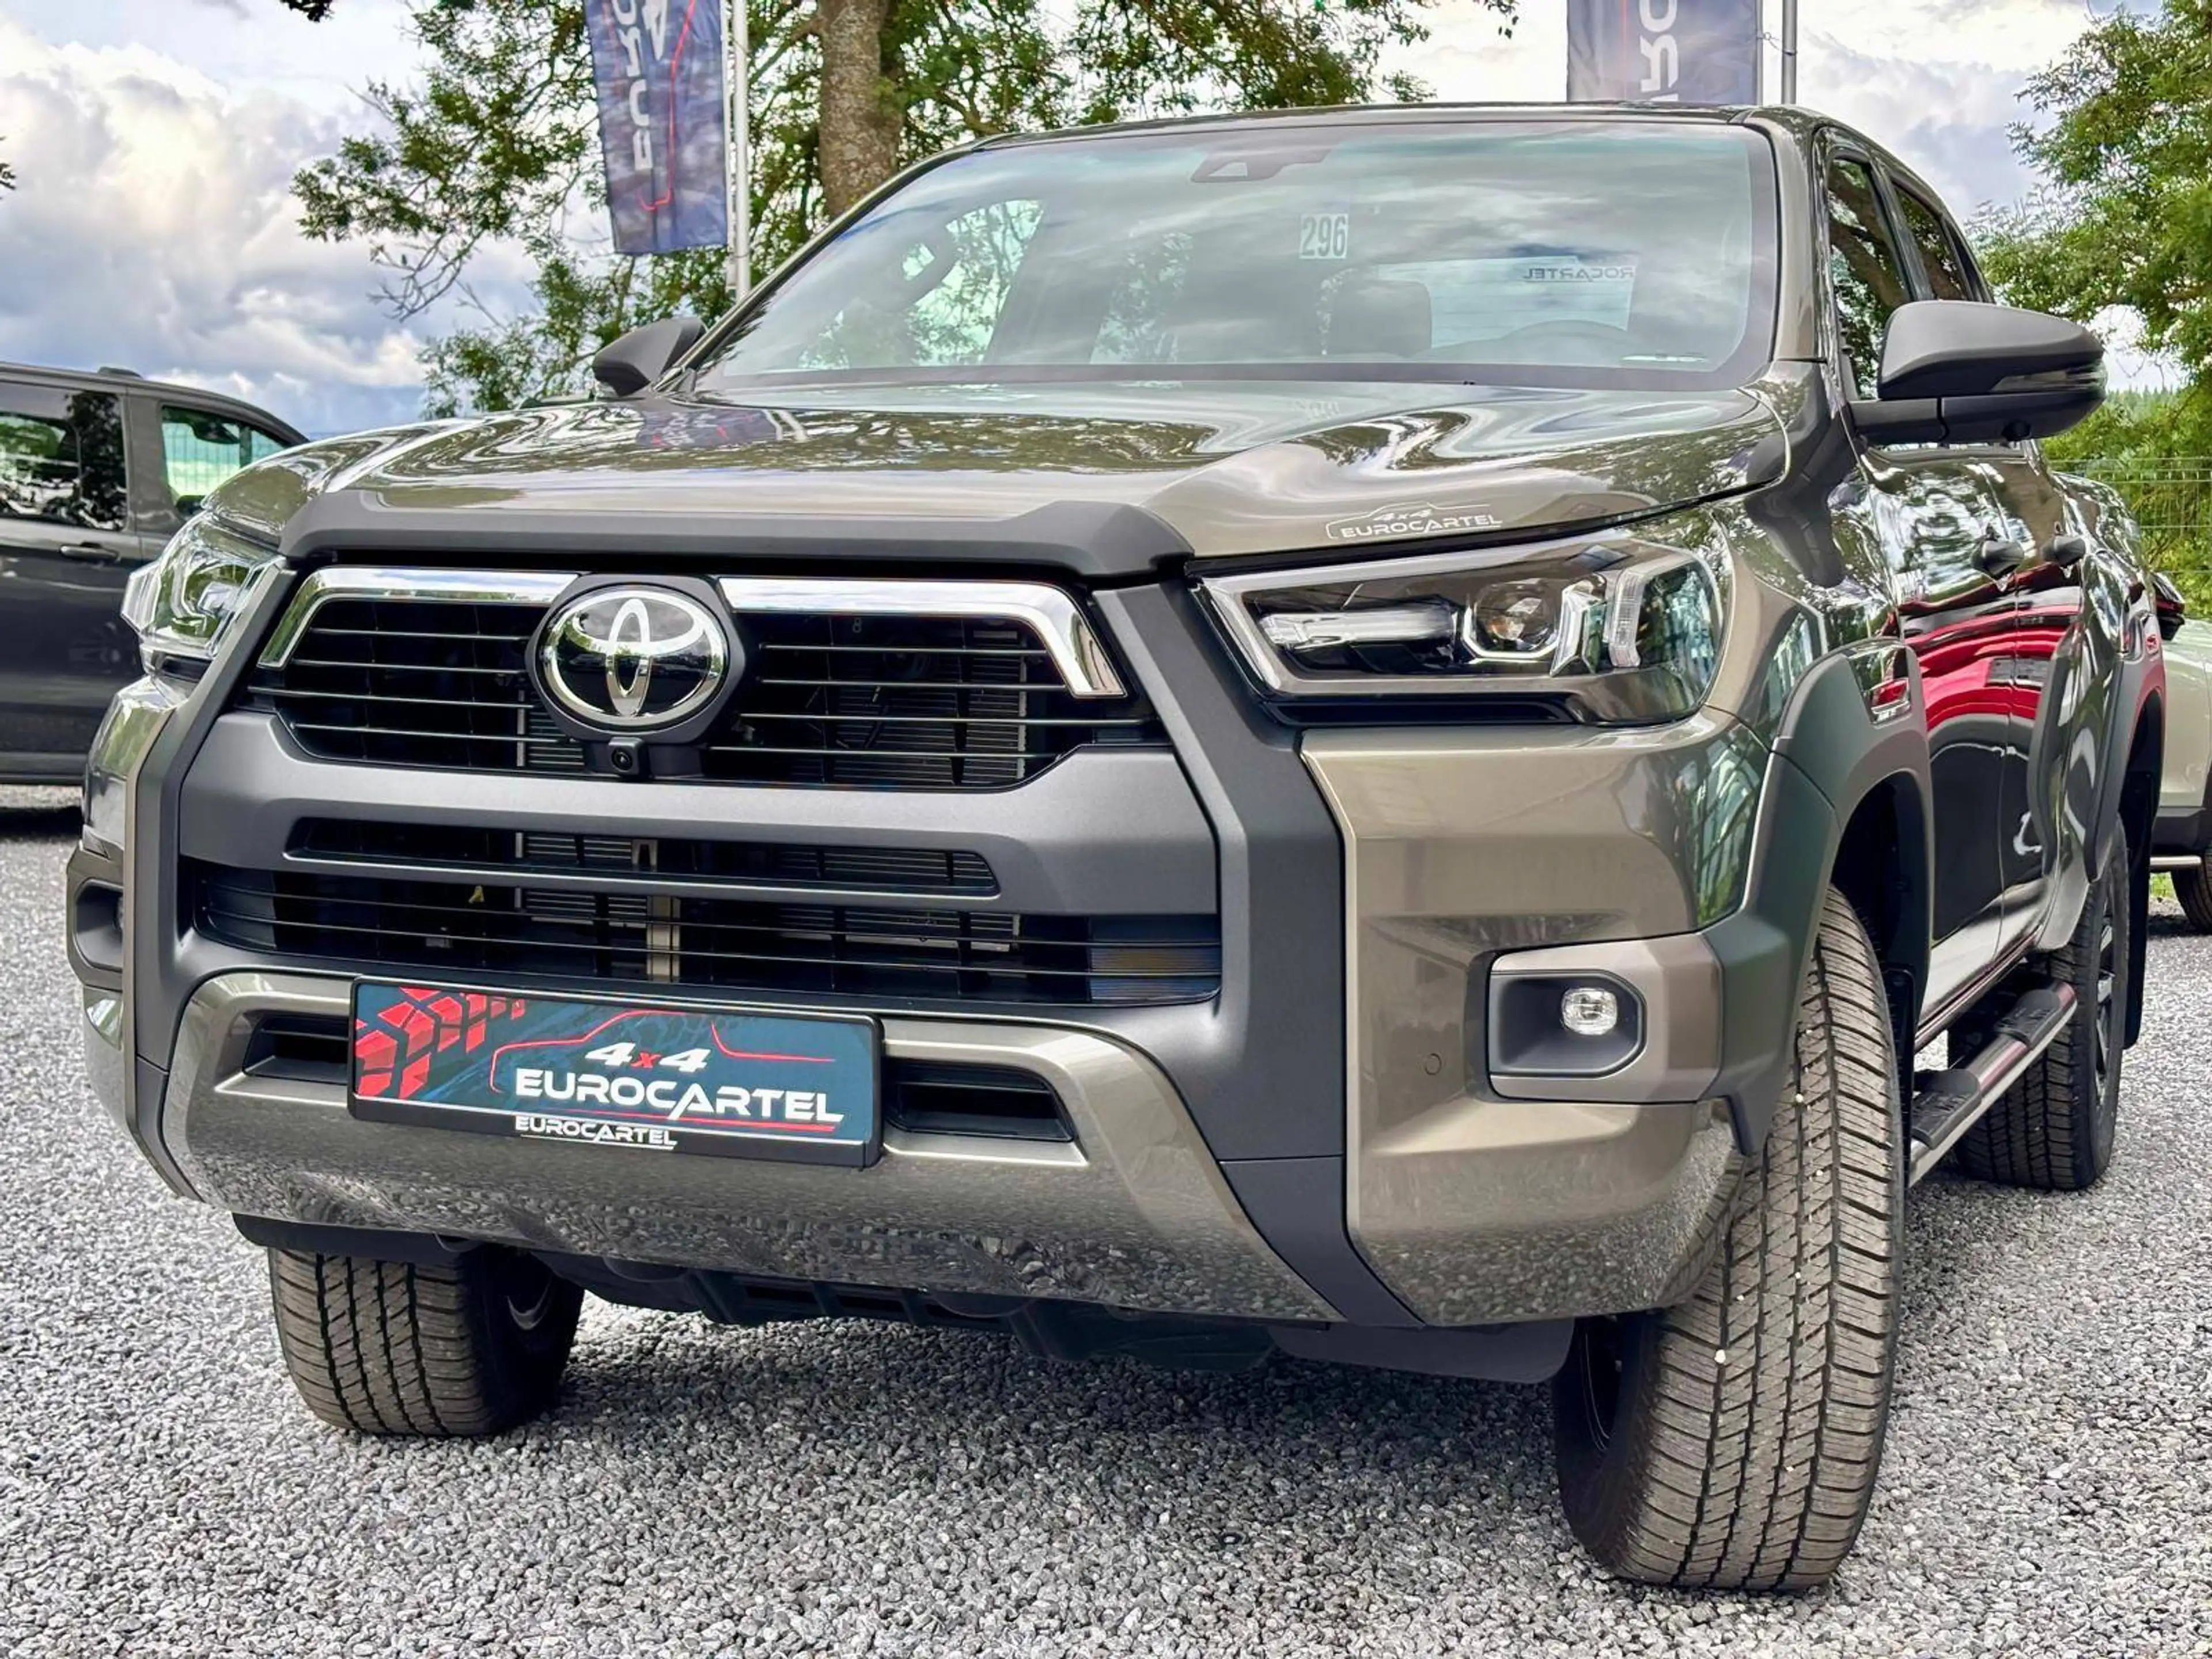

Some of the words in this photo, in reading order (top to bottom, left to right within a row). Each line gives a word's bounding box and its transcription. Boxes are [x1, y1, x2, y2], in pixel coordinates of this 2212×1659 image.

[1301, 215, 1347, 257] 296
[1339, 514, 1503, 538] EUROCARTEL
[585, 1041, 711, 1073] 4x4
[516, 1067, 844, 1123] EUROCARTEL
[514, 1115, 678, 1146] EUROCARTEL
